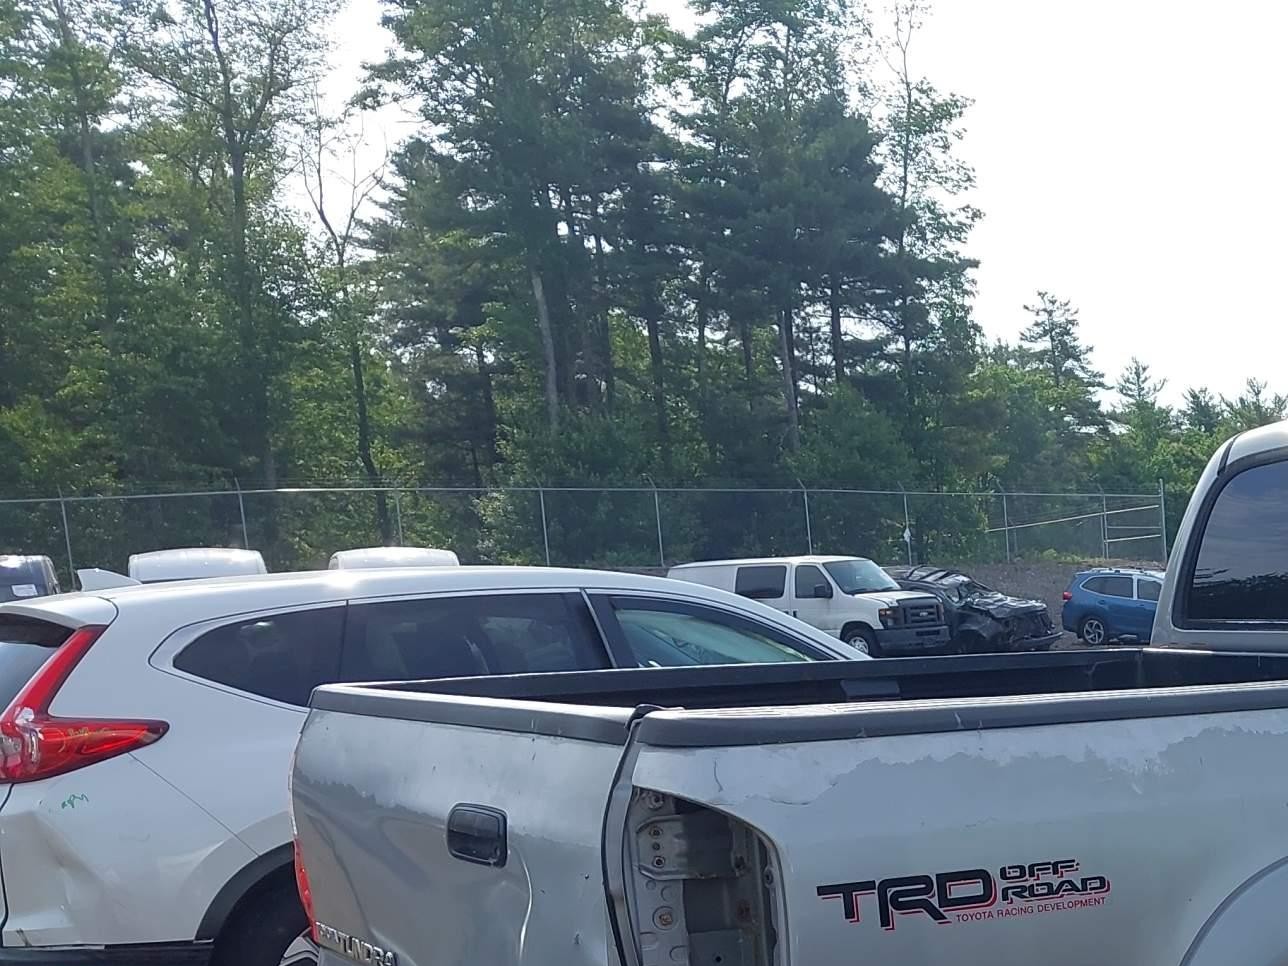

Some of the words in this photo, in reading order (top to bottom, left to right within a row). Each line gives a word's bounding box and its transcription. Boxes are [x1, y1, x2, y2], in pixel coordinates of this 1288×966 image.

[999, 859, 1081, 881] OFF
[816, 868, 998, 931] TRD
[1001, 875, 1111, 904] ROAD
[956, 910, 994, 923] TOYOTA
[997, 904, 1034, 918] RACING
[1037, 896, 1106, 913] DEVELOPMENT
